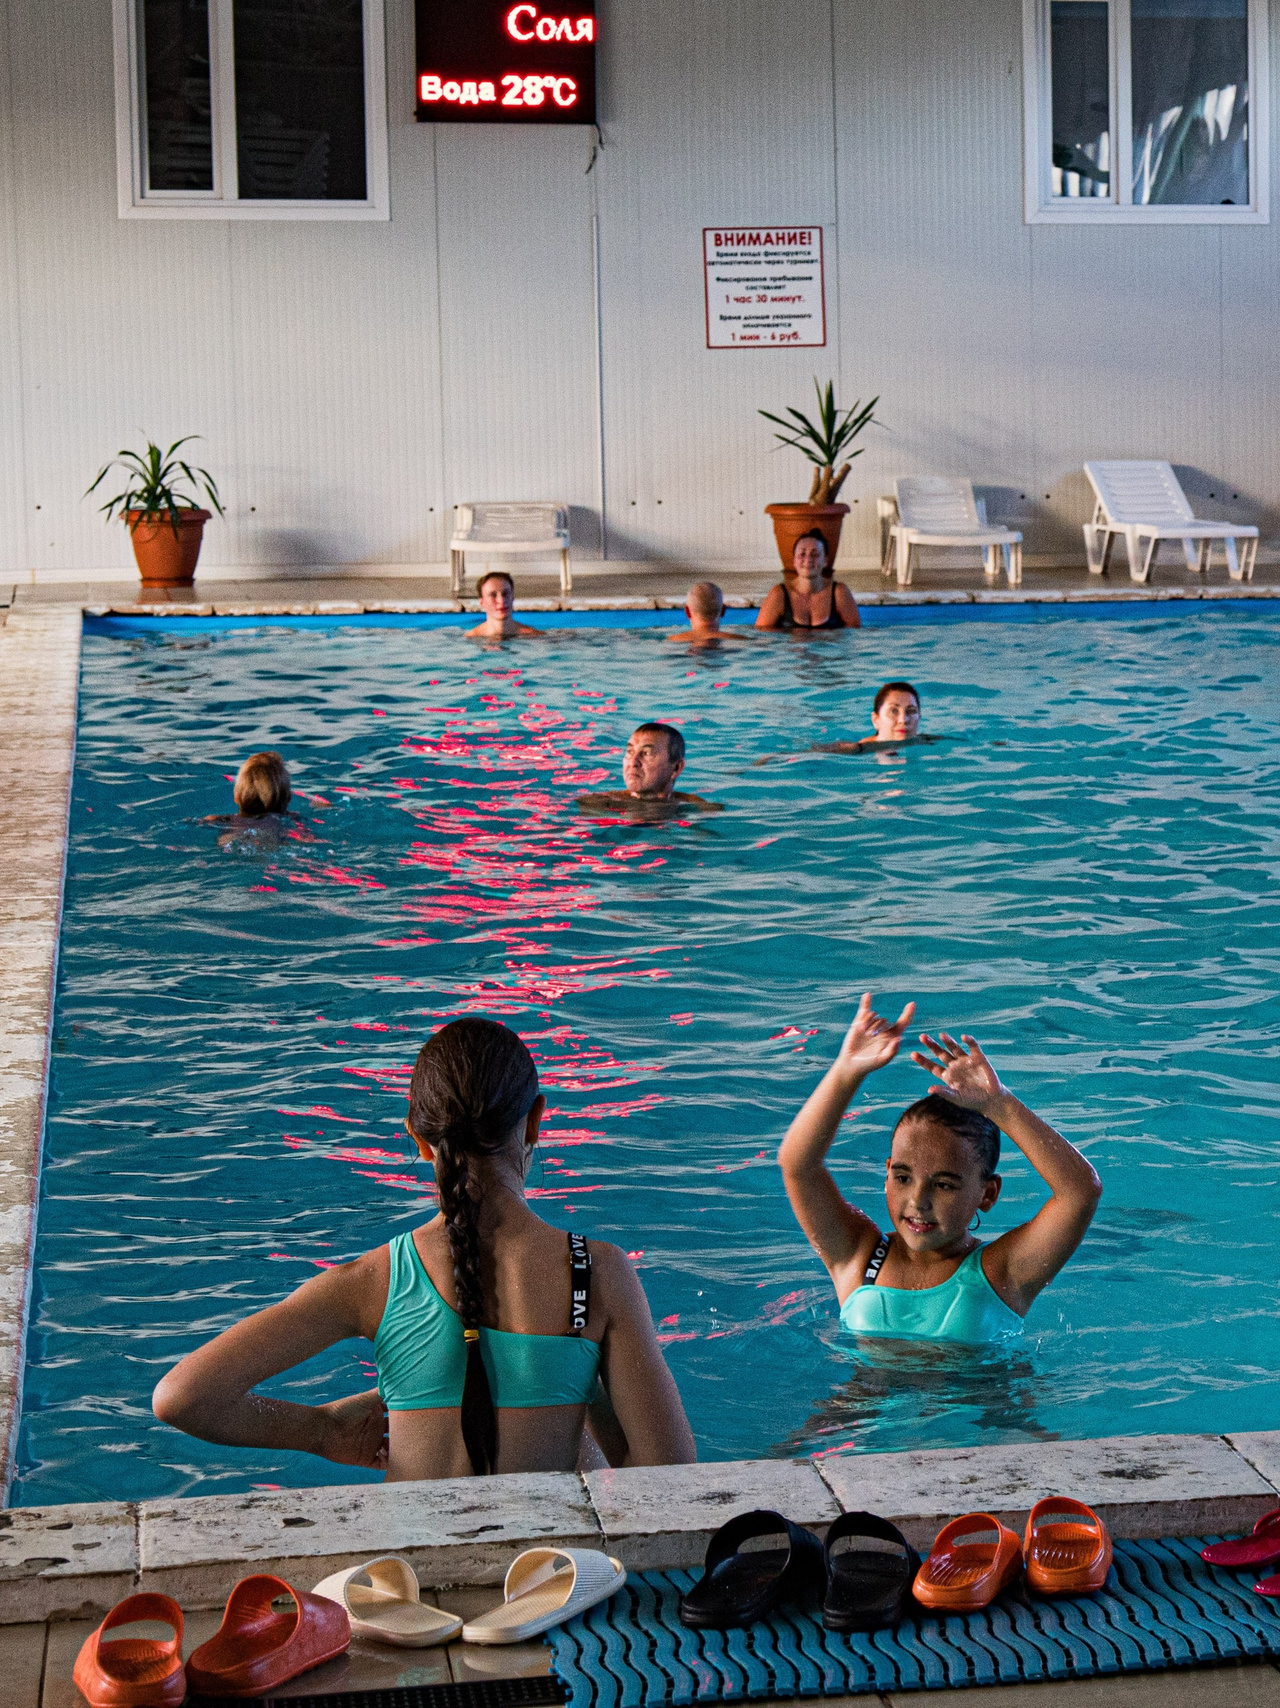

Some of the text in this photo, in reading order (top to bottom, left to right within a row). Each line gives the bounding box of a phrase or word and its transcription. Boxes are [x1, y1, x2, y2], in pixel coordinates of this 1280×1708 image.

[506, 4, 595, 42] Соля
[420, 74, 497, 105] Вода
[714, 231, 812, 247] ВНИМАНИЕ!
[725, 294, 730, 303] 1
[756, 294, 768, 303] 30
[731, 332, 736, 341] 1
[779, 331, 801, 342] руб.
[571, 1233, 587, 1269] LOVE
[573, 1290, 587, 1329] OVE
